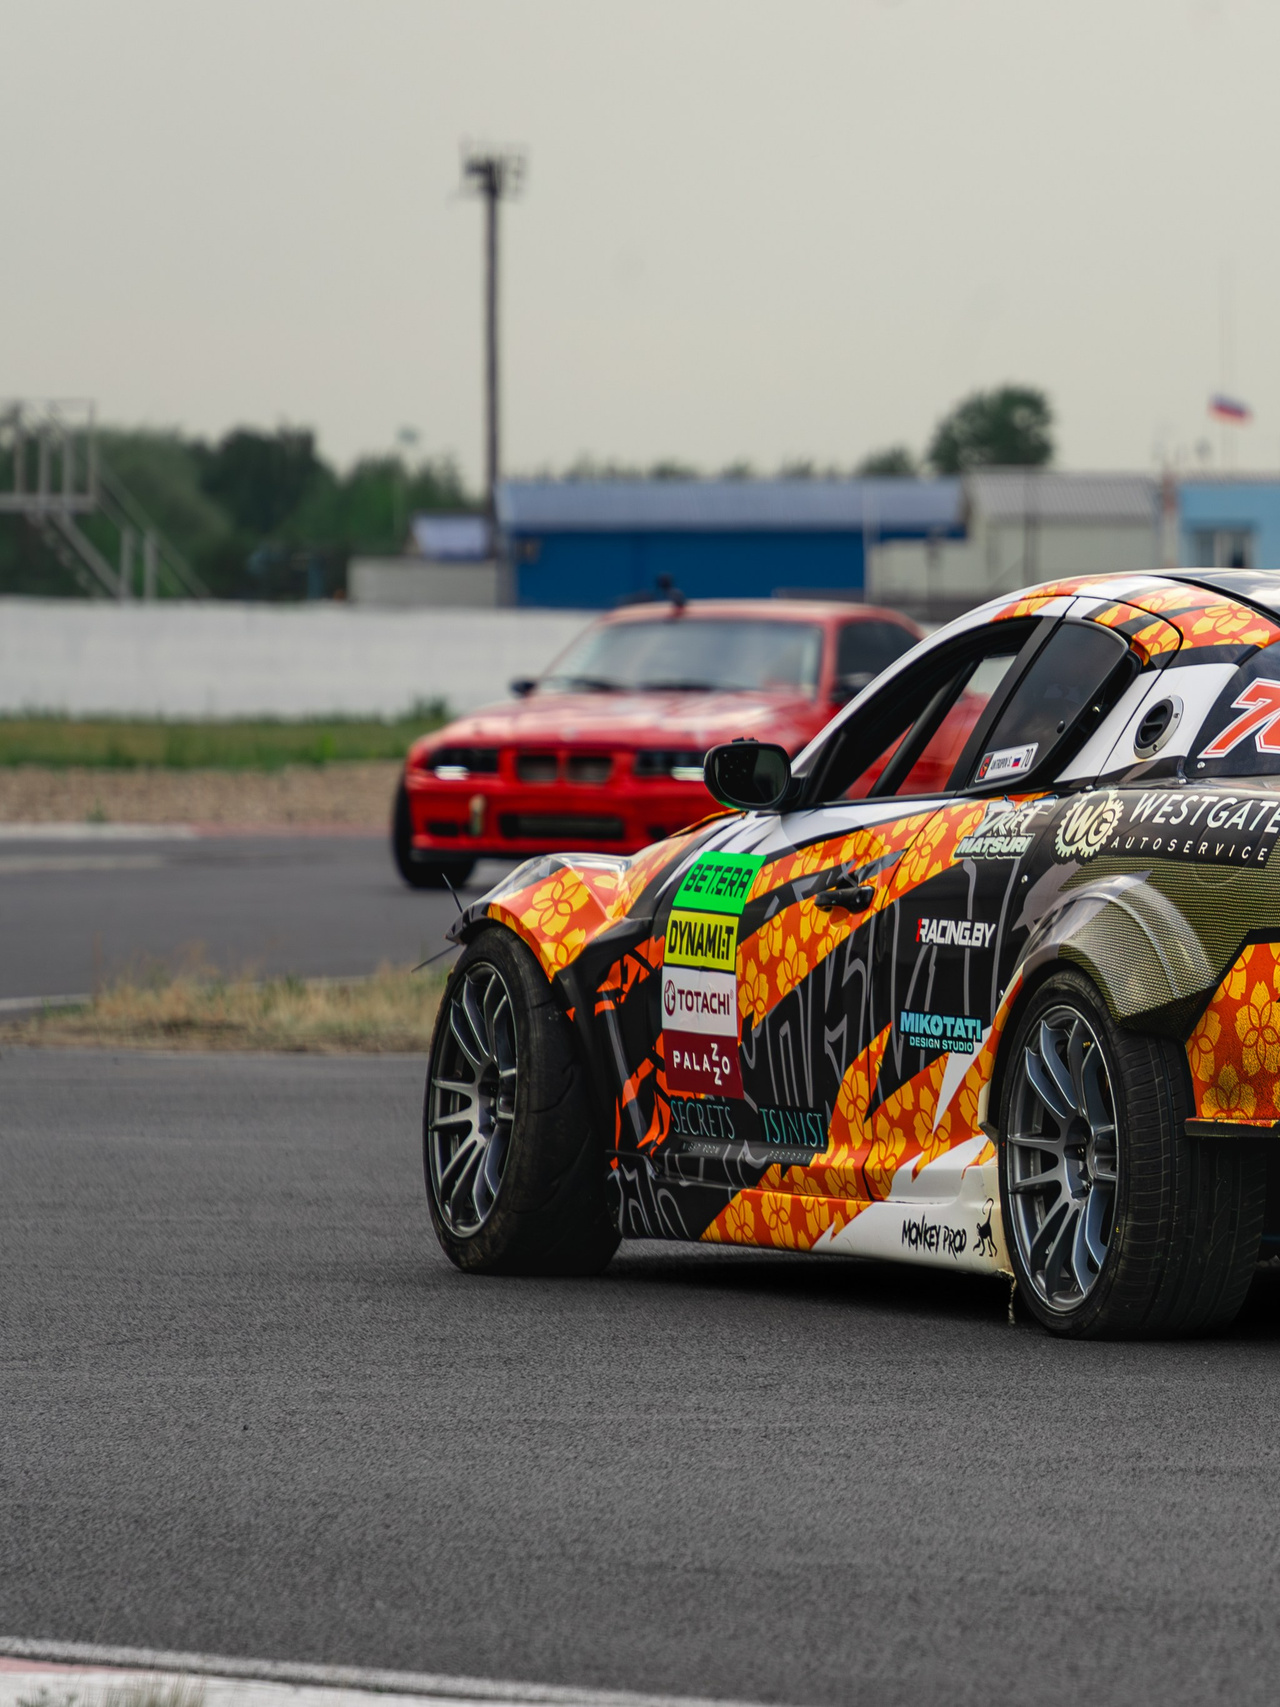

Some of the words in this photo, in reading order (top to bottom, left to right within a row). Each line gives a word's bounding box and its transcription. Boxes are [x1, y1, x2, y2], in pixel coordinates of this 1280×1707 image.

[974, 800, 1049, 837] DRIFT
[954, 836, 1034, 857] MATSURI
[1111, 836, 1268, 861] AUTOSERVICE
[677, 988, 731, 1015] TOTACHI
[900, 1011, 982, 1040] MIKOTATI
[909, 1036, 940, 1049] DESIGN
[942, 1040, 973, 1053] STUDIO
[673, 1043, 731, 1086] PALAZZO
[670, 1099, 735, 1140] SECRETS
[902, 1212, 941, 1254] MONKEY
[943, 1225, 967, 1260] PROD
